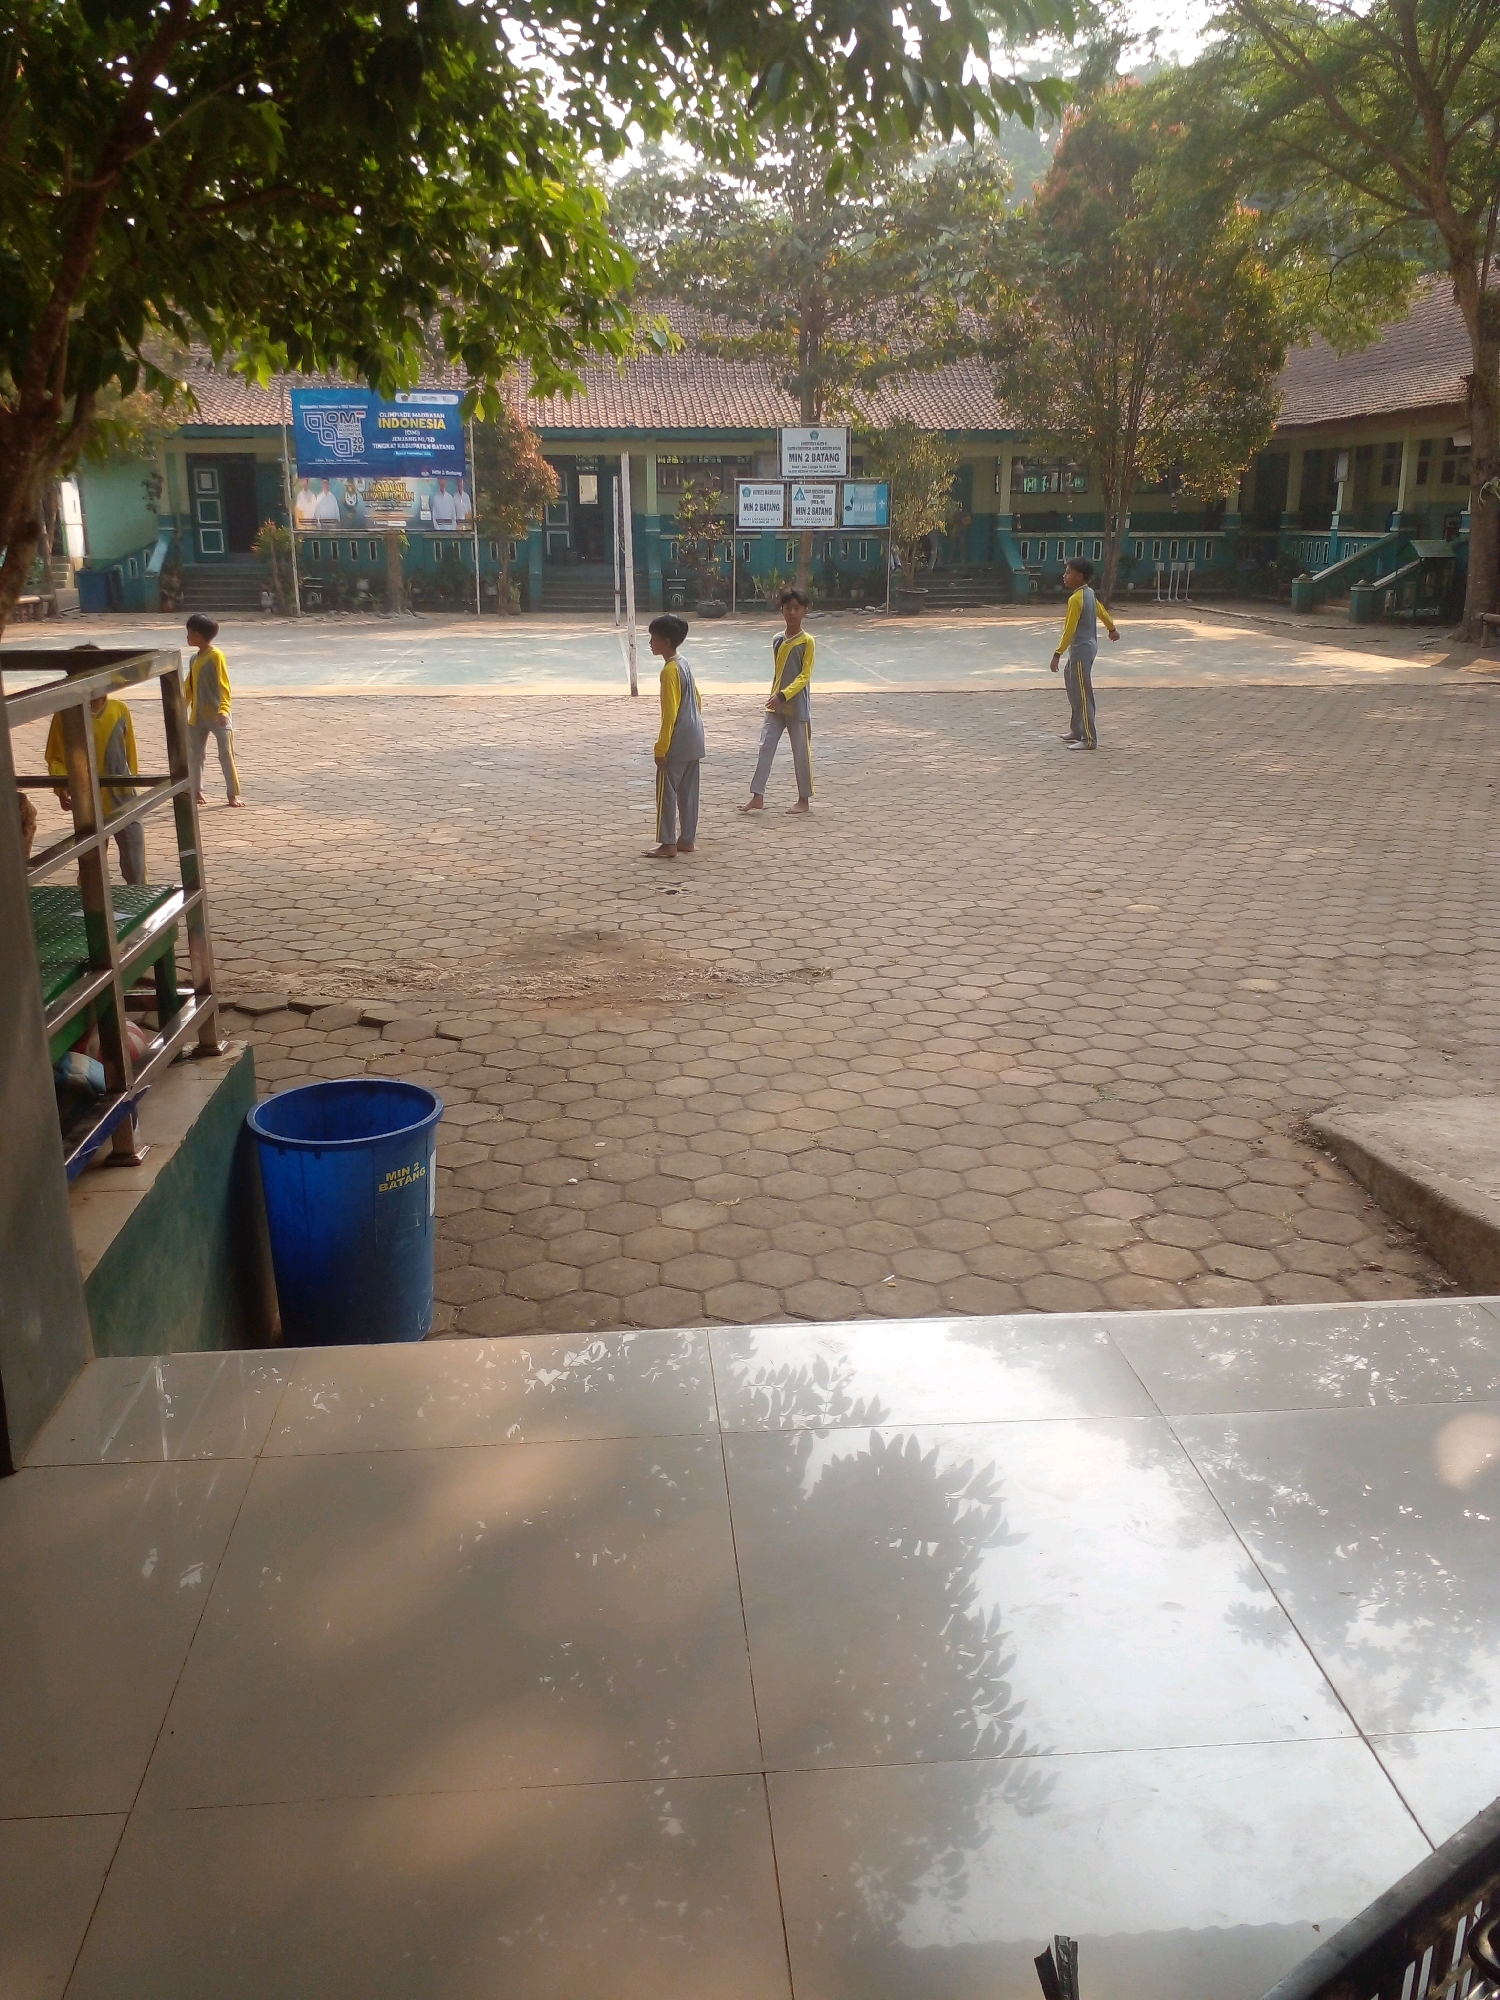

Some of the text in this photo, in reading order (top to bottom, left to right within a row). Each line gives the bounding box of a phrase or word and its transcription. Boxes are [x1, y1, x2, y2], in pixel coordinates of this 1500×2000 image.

[378, 418, 446, 430] INDONESIA
[353, 444, 364, 452] 26
[788, 453, 840, 463] MIN 2 BATANG
[743, 503, 780, 511] MIN 2 BATANG
[795, 506, 832, 515] MIN 2 BATANG
[386, 1162, 420, 1181] MIN 2
[379, 1167, 426, 1192] BATANG
